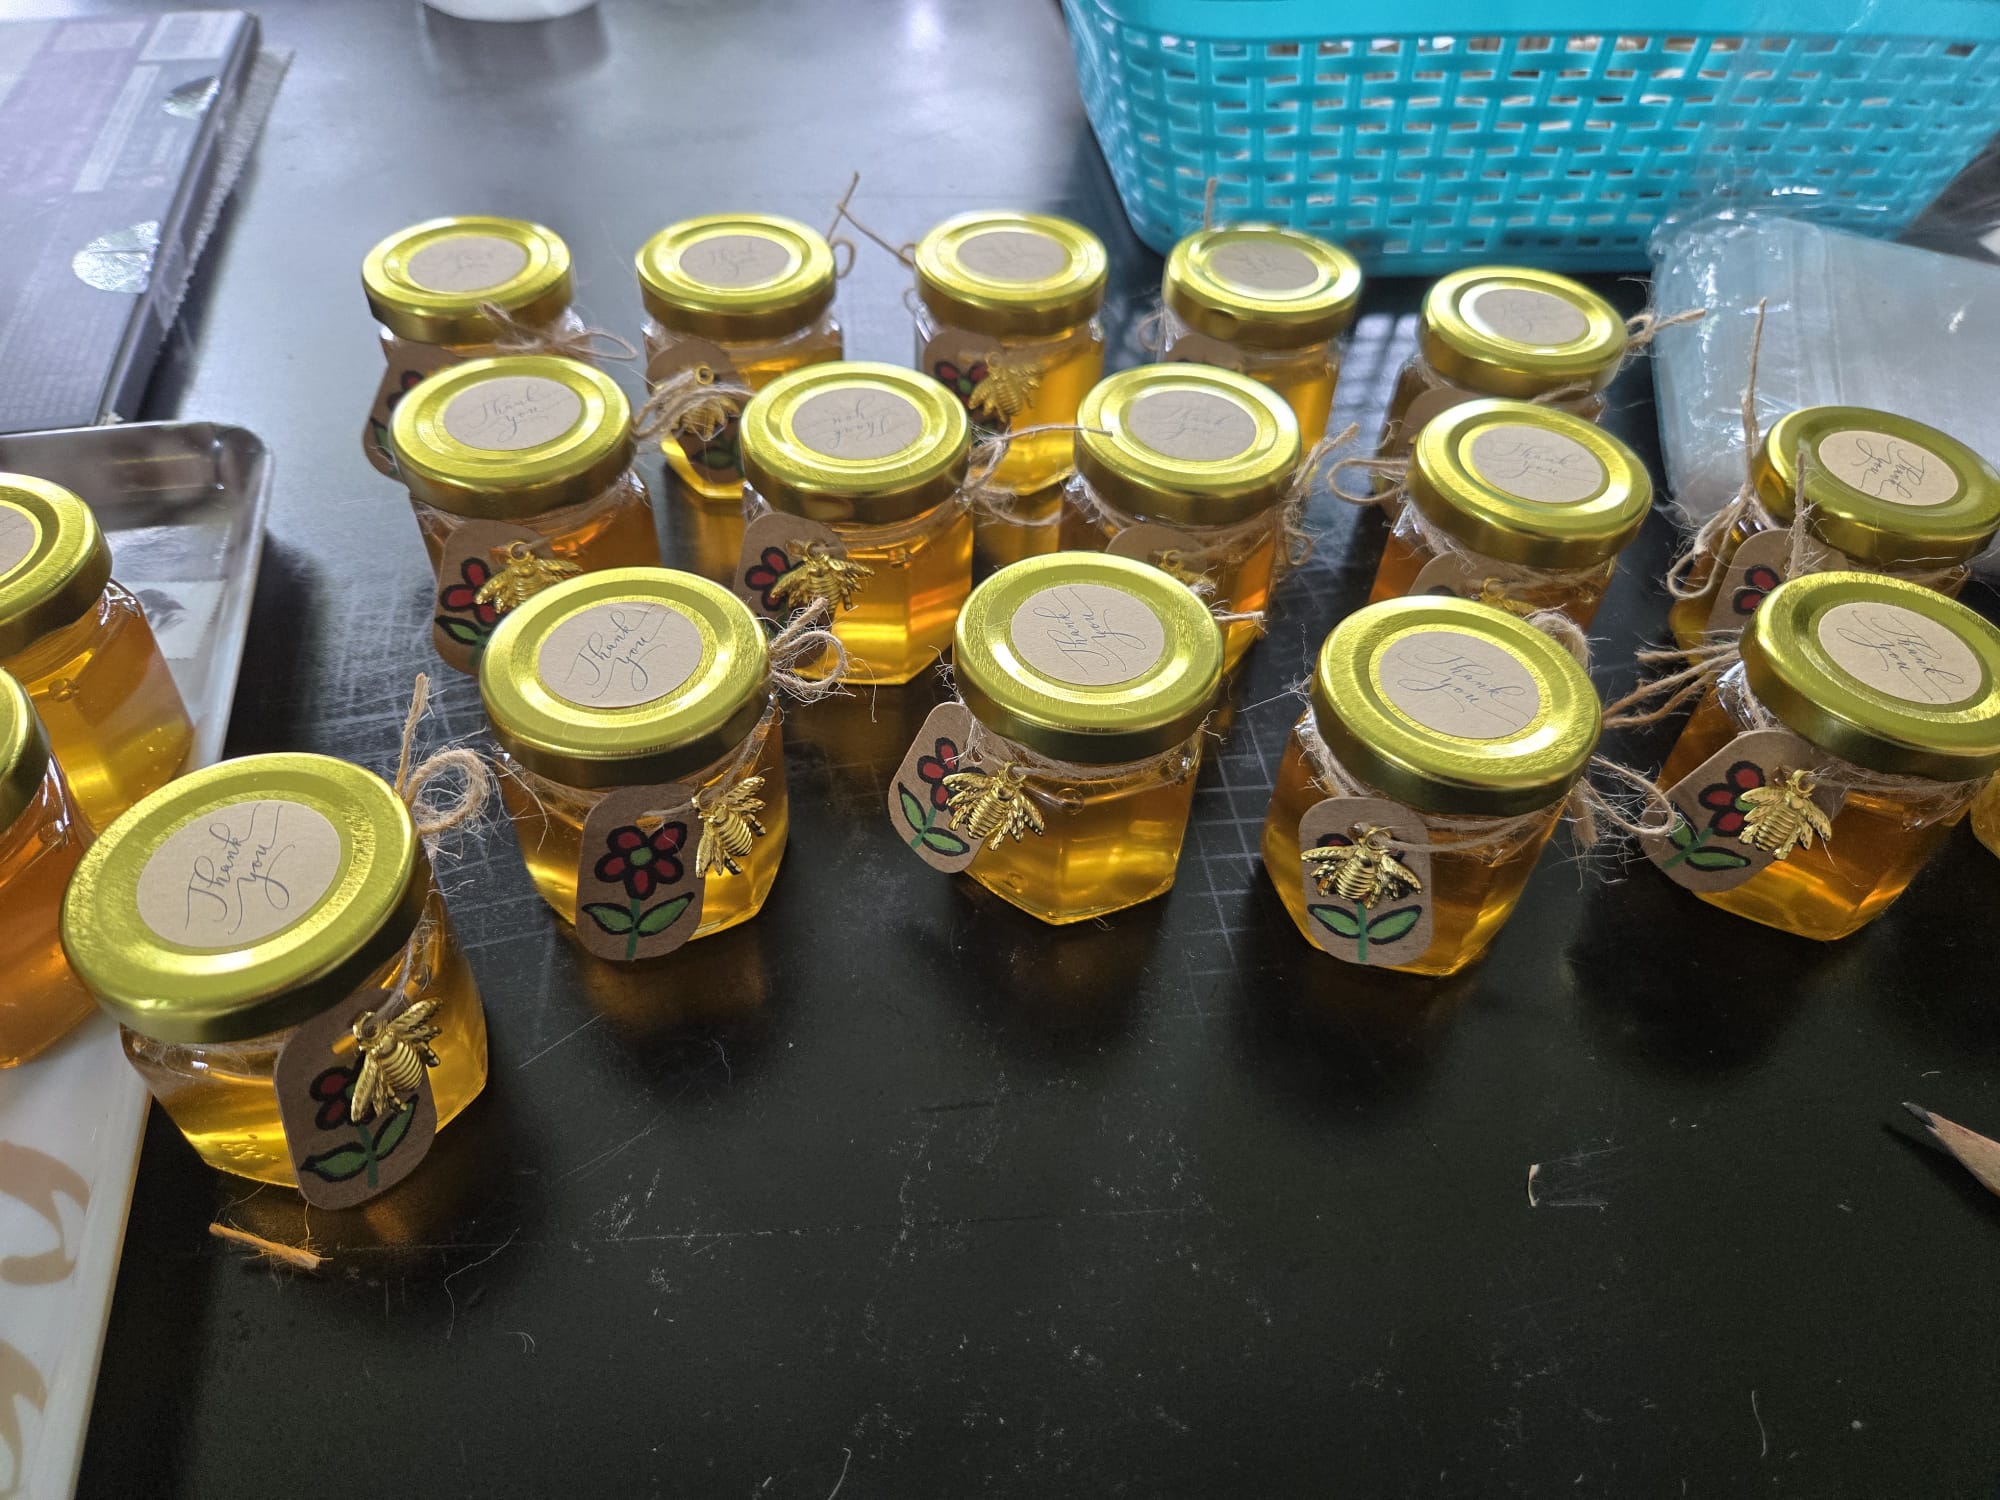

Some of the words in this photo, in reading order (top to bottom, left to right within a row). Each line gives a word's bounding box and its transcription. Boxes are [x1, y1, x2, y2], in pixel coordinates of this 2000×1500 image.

[1875, 449, 1925, 498] Thank
[563, 604, 656, 686] Thank
[592, 612, 670, 698] you
[1033, 589, 1110, 675] Thank
[1069, 587, 1146, 672] you
[1836, 610, 1933, 701] you
[1870, 611, 1964, 702] Thank
[1397, 652, 1517, 727] you
[1414, 640, 1530, 719] Thank
[185, 803, 261, 931] Thank
[228, 805, 296, 936] you
